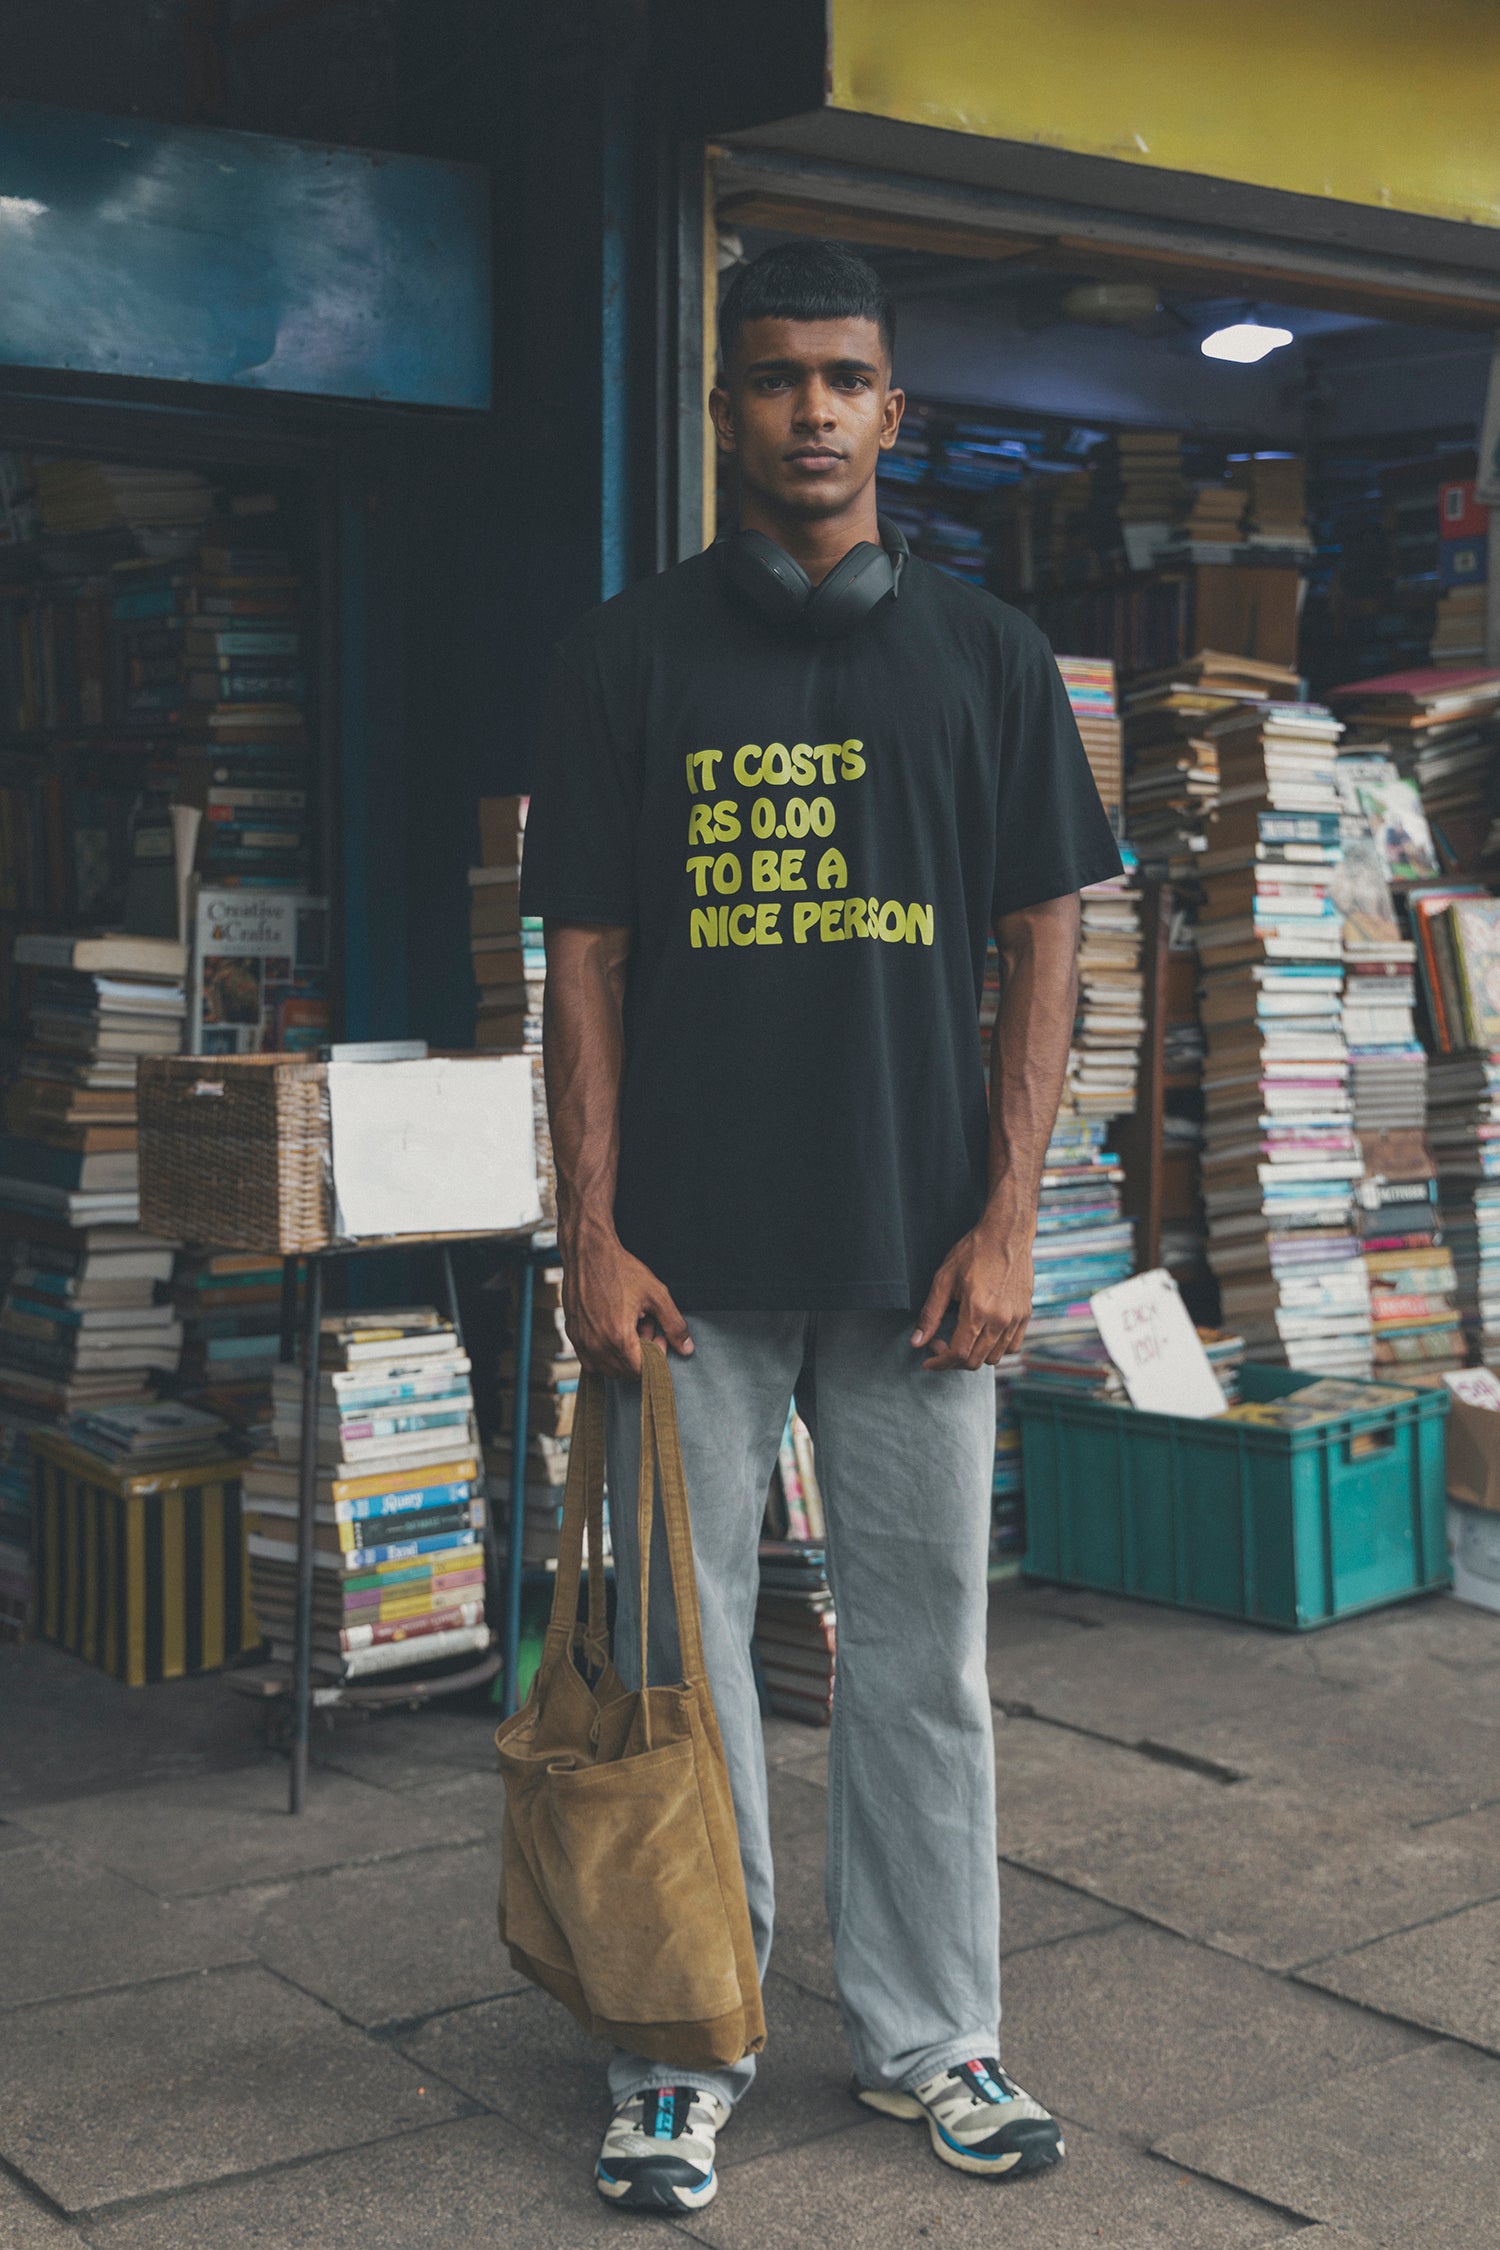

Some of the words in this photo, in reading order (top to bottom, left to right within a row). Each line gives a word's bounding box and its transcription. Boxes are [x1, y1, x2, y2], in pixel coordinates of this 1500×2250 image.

[686, 749, 723, 794] IT
[733, 739, 866, 787] COSTS
[688, 800, 742, 845] RS
[751, 796, 836, 839] 0.00
[686, 852, 742, 897] TO
[752, 849, 808, 892] BE
[817, 847, 848, 890] A
[208, 900, 284, 921] Creative
[223, 918, 283, 942] Crafts
[690, 903, 783, 948] NICE
[793, 897, 934, 946] PERSON
